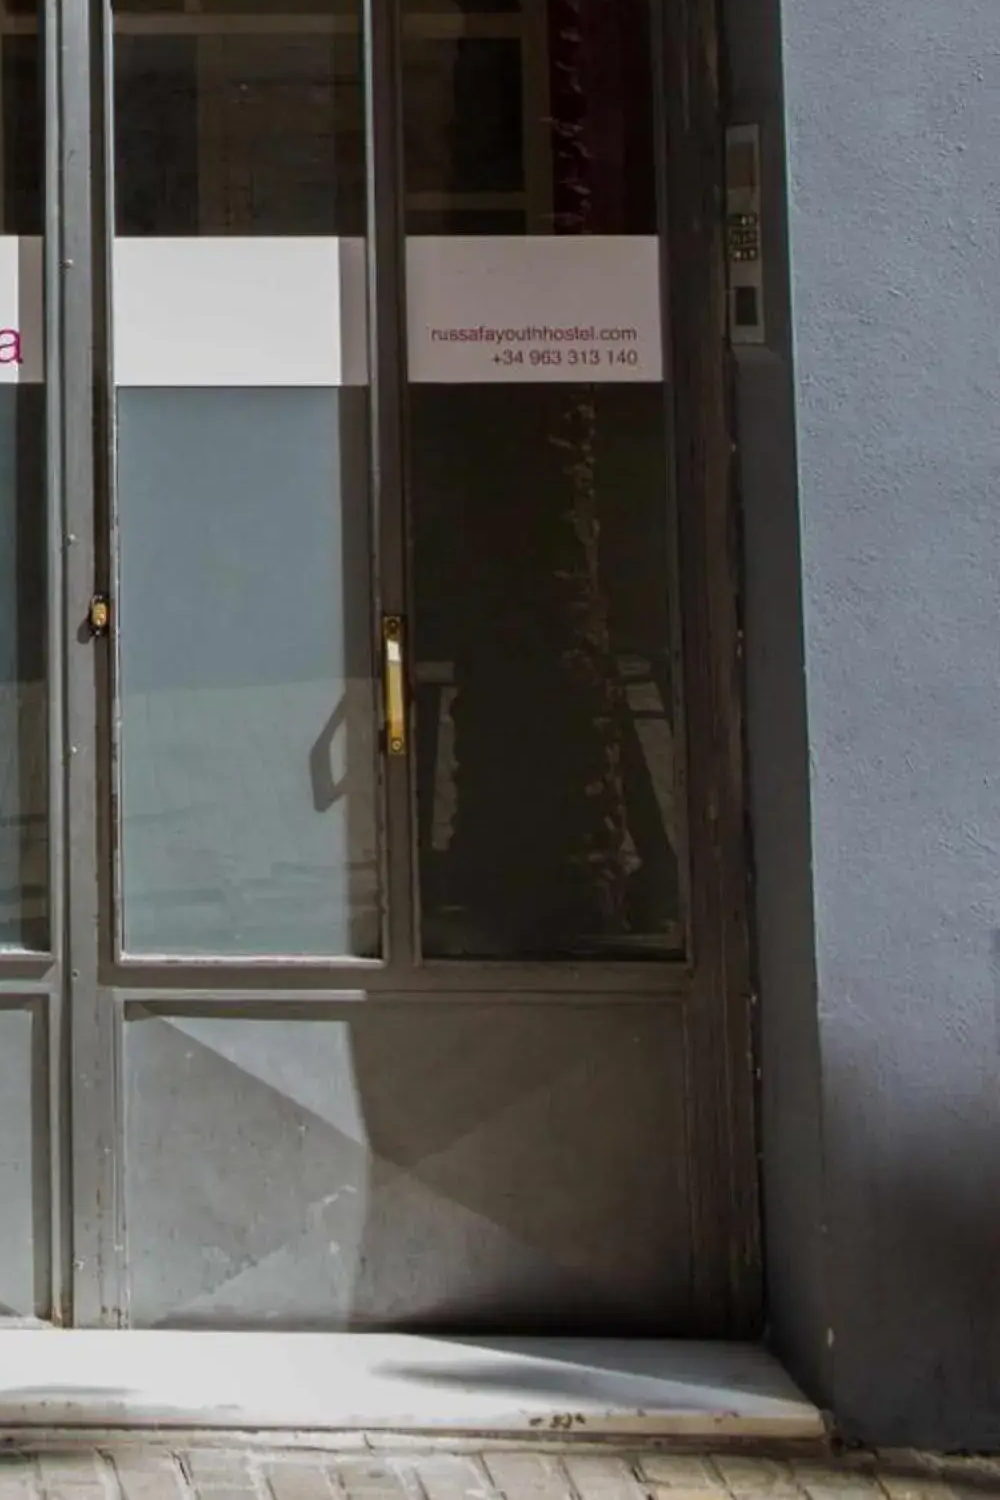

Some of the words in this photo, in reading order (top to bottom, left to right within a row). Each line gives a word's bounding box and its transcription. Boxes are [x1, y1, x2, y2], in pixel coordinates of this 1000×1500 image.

[431, 325, 637, 344] russafayouthhostel.com
[492, 350, 524, 365] +34
[529, 350, 561, 365] 963
[567, 350, 600, 365] 313
[608, 350, 638, 365] 140
